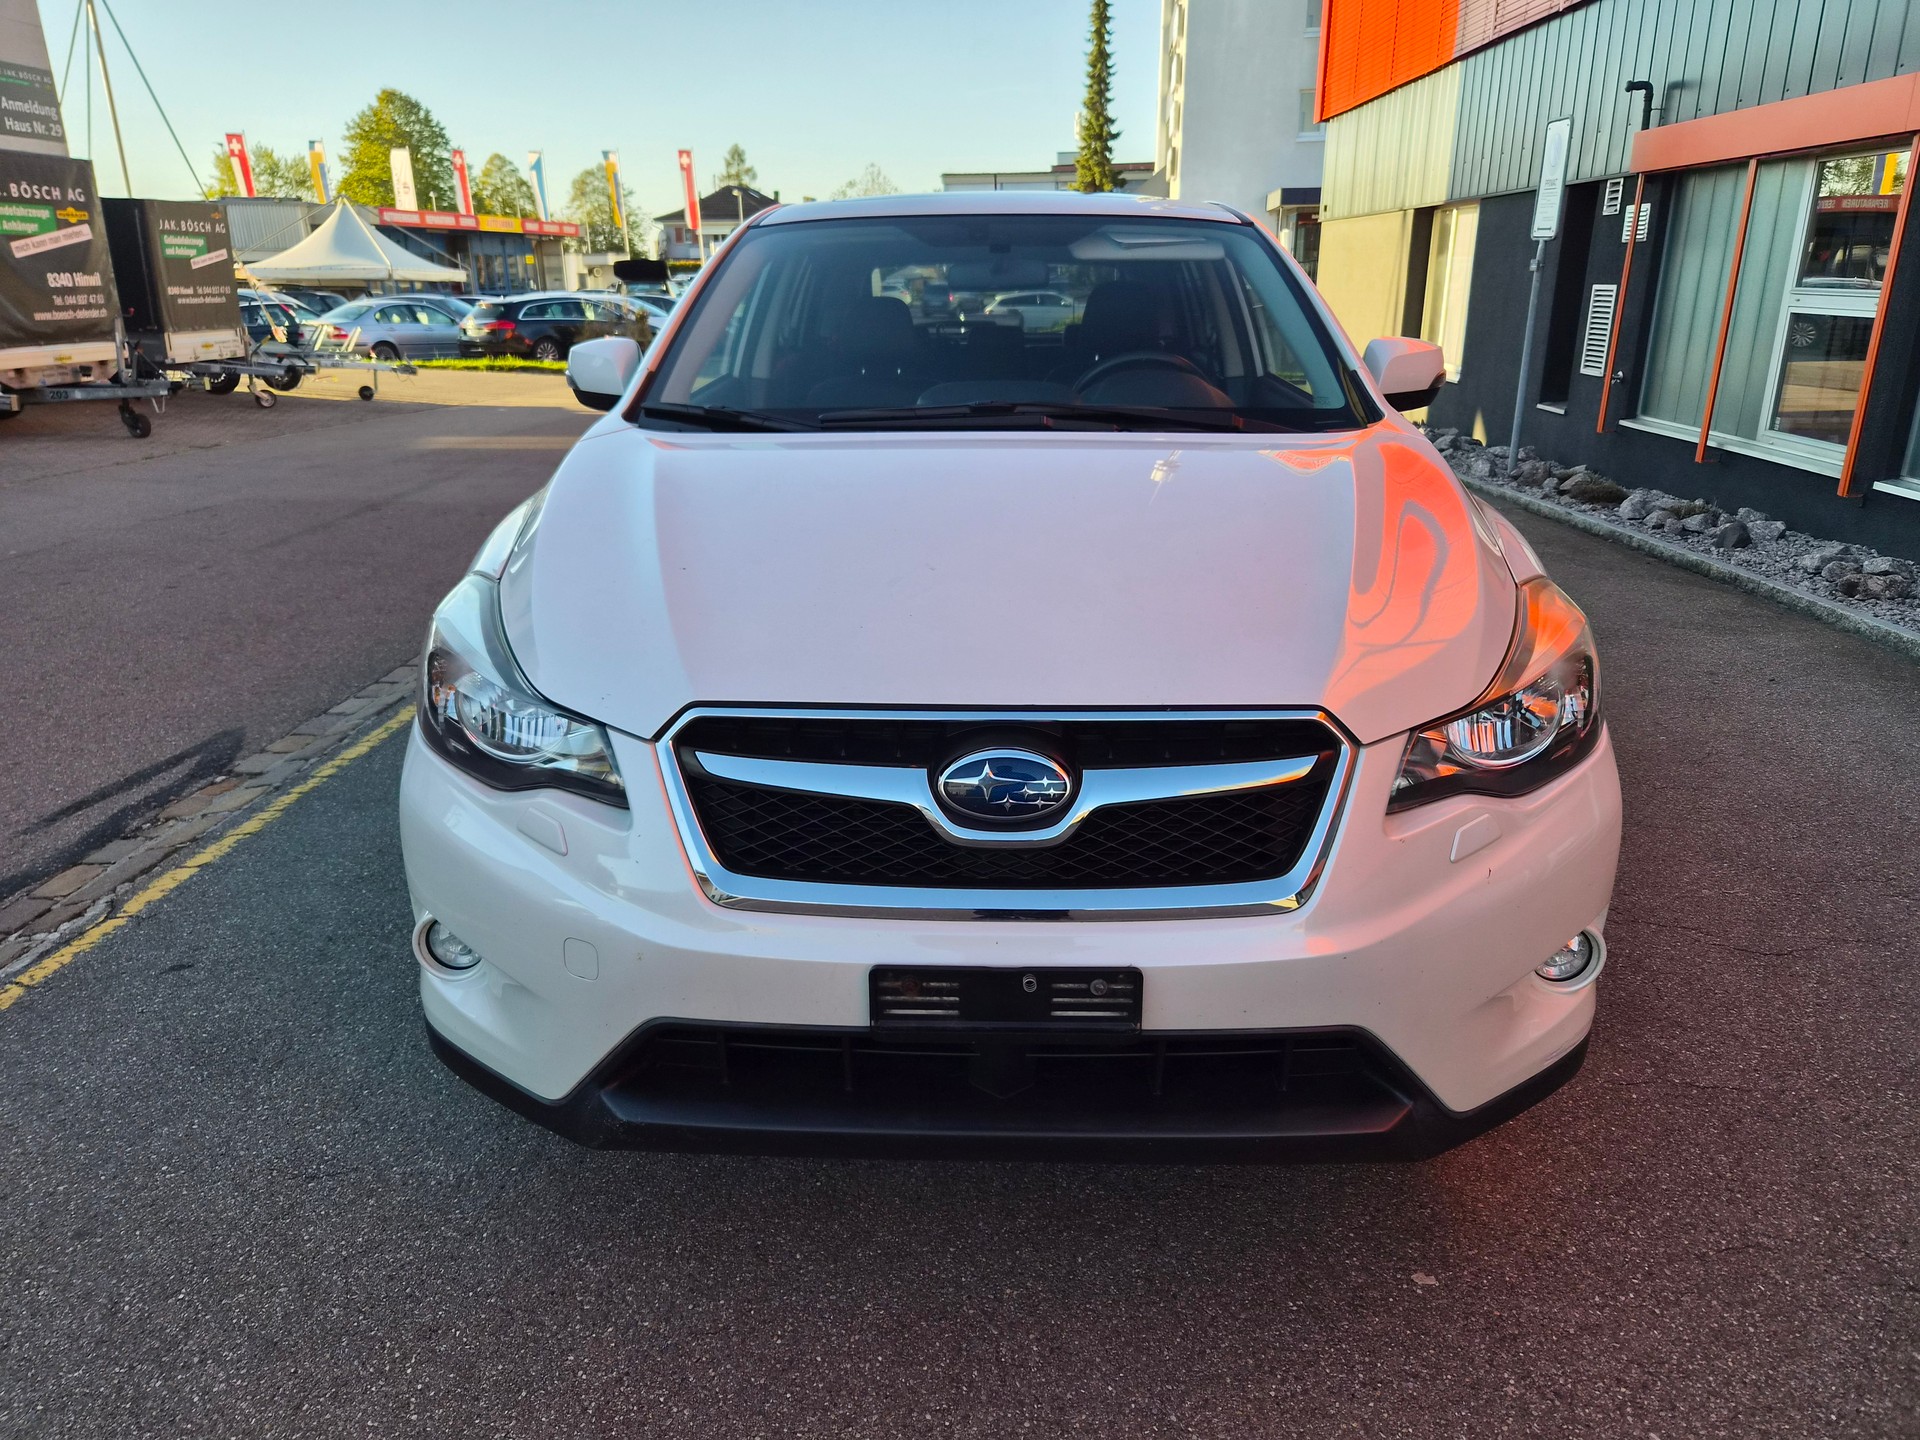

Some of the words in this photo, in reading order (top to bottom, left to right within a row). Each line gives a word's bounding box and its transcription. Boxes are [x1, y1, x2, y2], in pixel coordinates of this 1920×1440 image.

[2, 96, 58, 120] Anmeldung
[4, 116, 32, 133] Haus
[32, 121, 49, 135] Nr.
[49, 123, 63, 137] 29
[9, 181, 62, 200] BÖSCH
[67, 188, 86, 202] AG
[2, 220, 39, 234] Anhänger
[159, 219, 179, 231] JAK.
[180, 218, 212, 232] BÖSCH
[215, 223, 226, 234] AG
[47, 273, 72, 287] 8340
[73, 272, 101, 286] Hinwil
[53, 296, 64, 305] Tel.
[49, 390, 70, 400] 203
